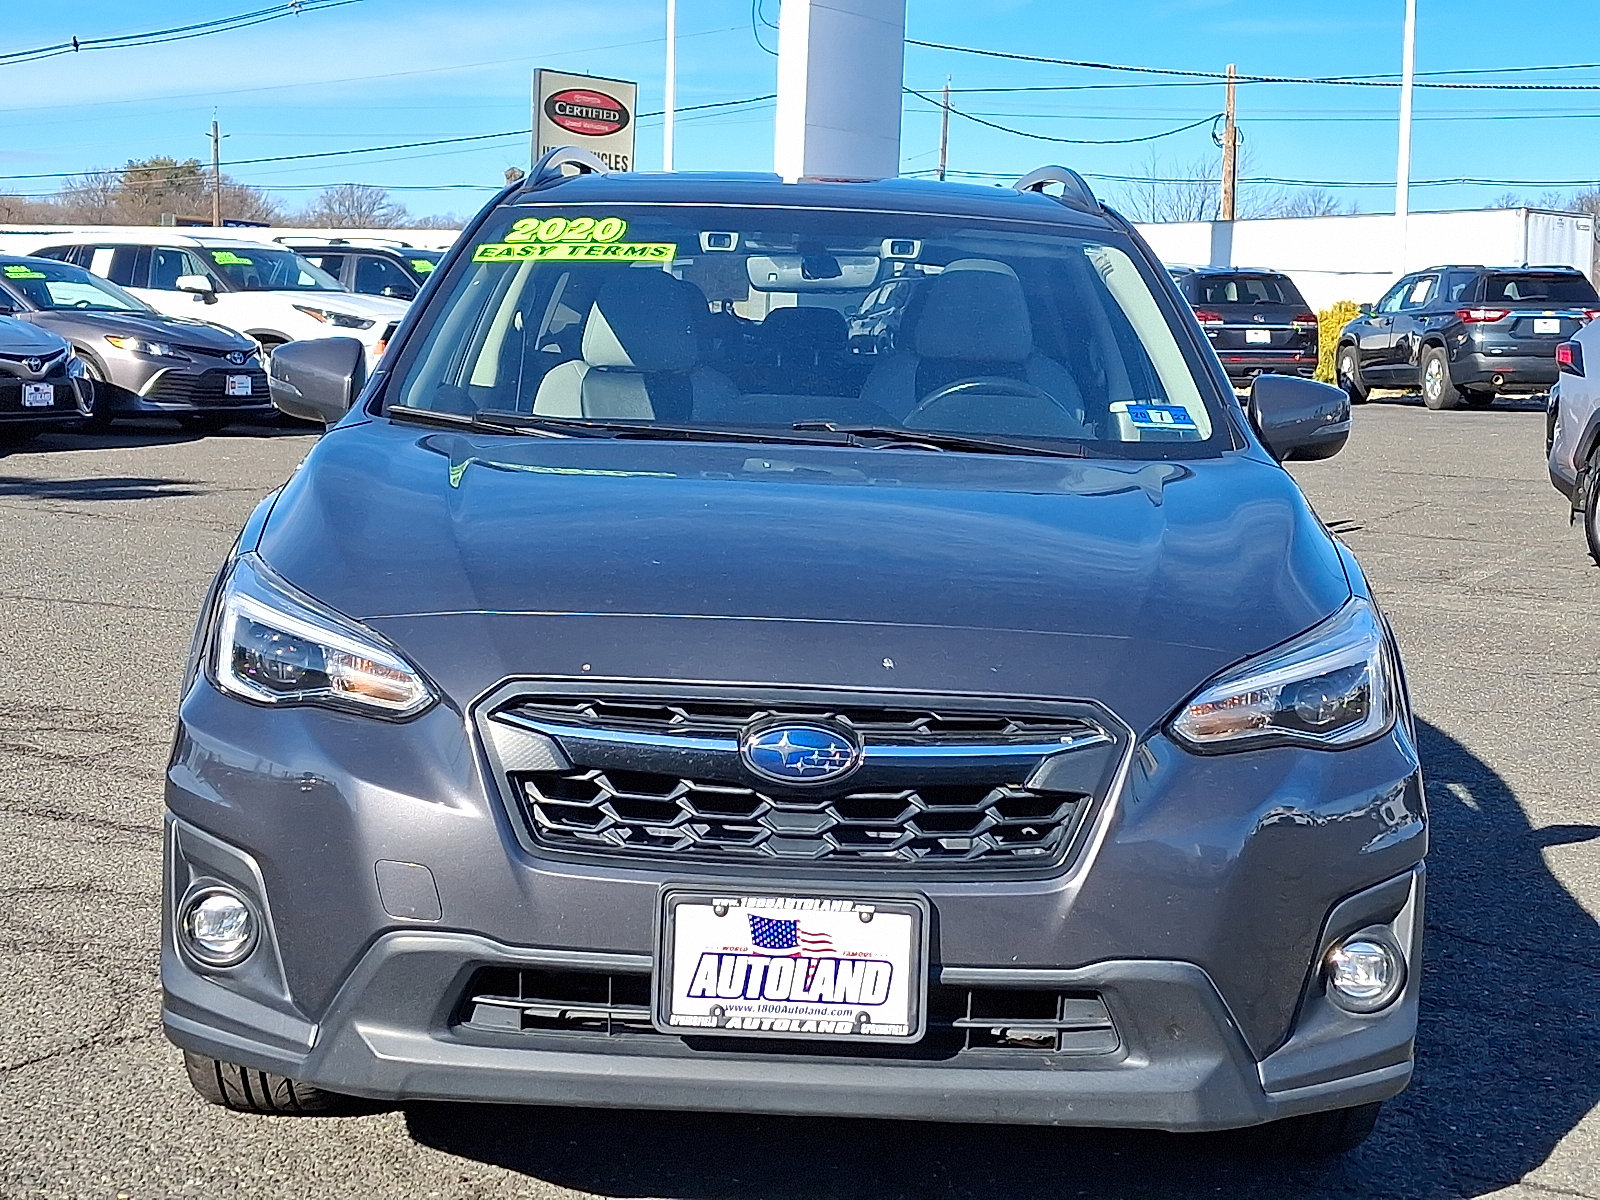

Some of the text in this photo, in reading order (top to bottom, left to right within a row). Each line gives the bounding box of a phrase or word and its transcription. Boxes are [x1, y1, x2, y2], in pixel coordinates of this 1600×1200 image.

[555, 101, 620, 122] CERTIFIED
[504, 217, 629, 243] 2020
[478, 245, 671, 258] EASY TERMS
[1133, 411, 1147, 420] 20
[1154, 411, 1165, 422] 7
[842, 950, 873, 958] FAMOUS
[686, 952, 894, 1006] AUTOLAND
[725, 1004, 853, 1017] www.1800Autoland.com
[725, 1017, 855, 1034] AUTOLAND
